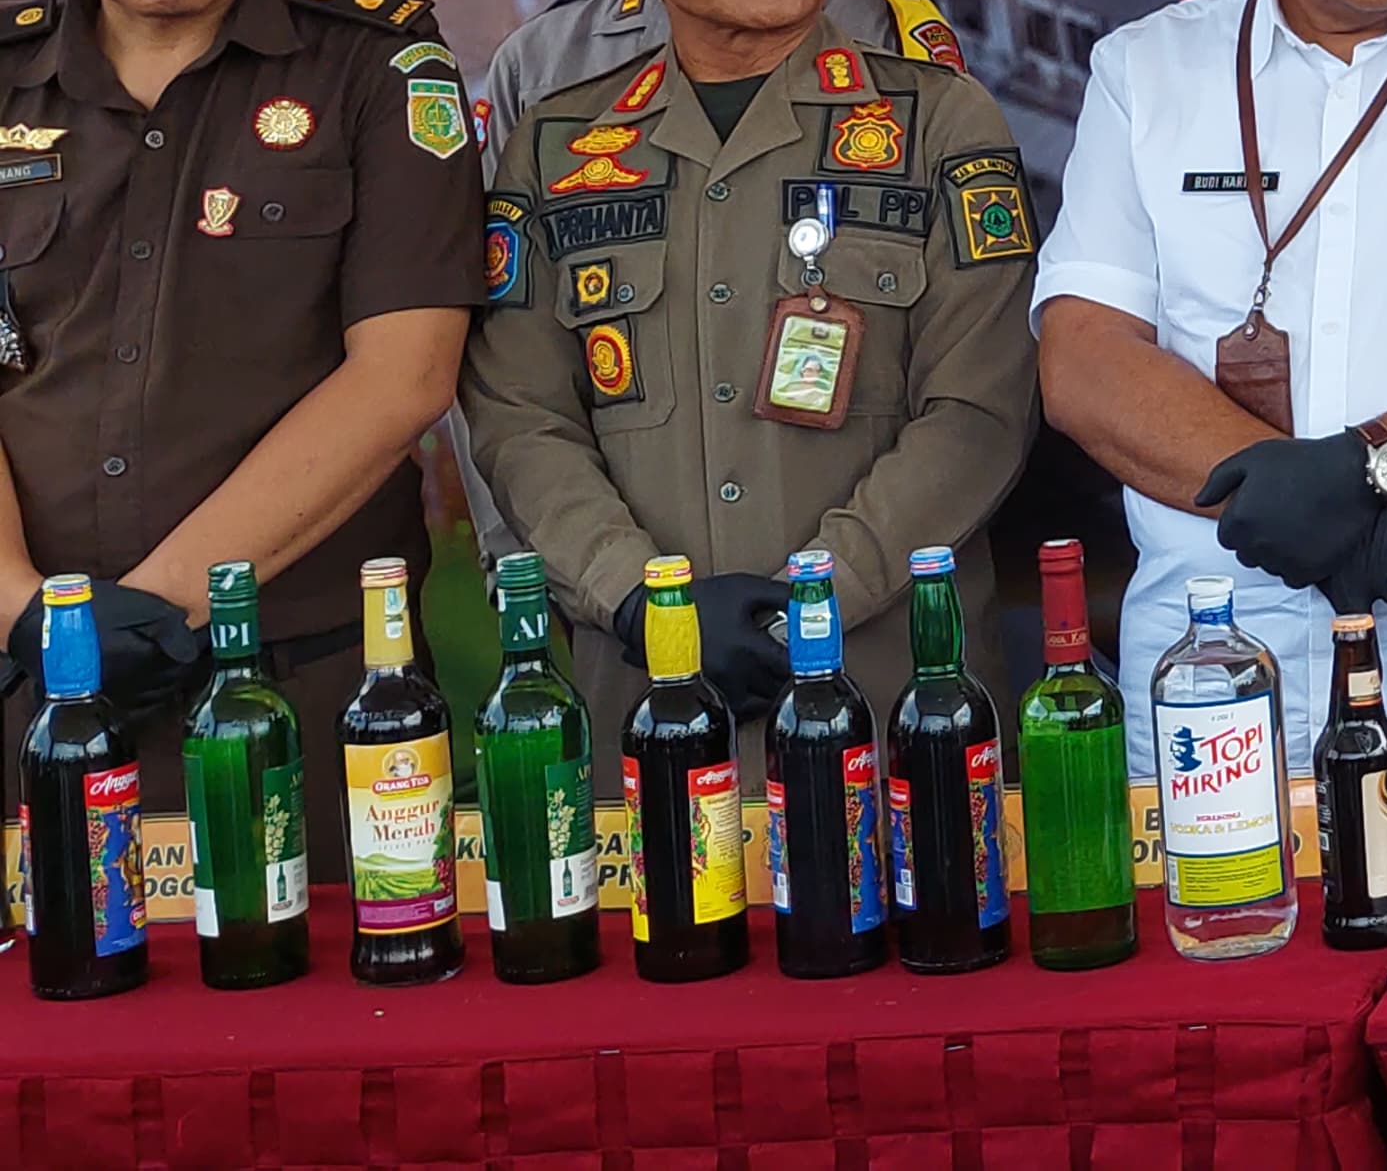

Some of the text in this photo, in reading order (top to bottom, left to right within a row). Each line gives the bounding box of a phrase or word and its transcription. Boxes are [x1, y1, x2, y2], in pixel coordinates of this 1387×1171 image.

[791, 186, 925, 227] PL PP
[1199, 722, 1264, 766] TOPI
[1171, 749, 1261, 800] MIRING
[365, 800, 441, 824] Anggur
[372, 818, 436, 843] Merah
